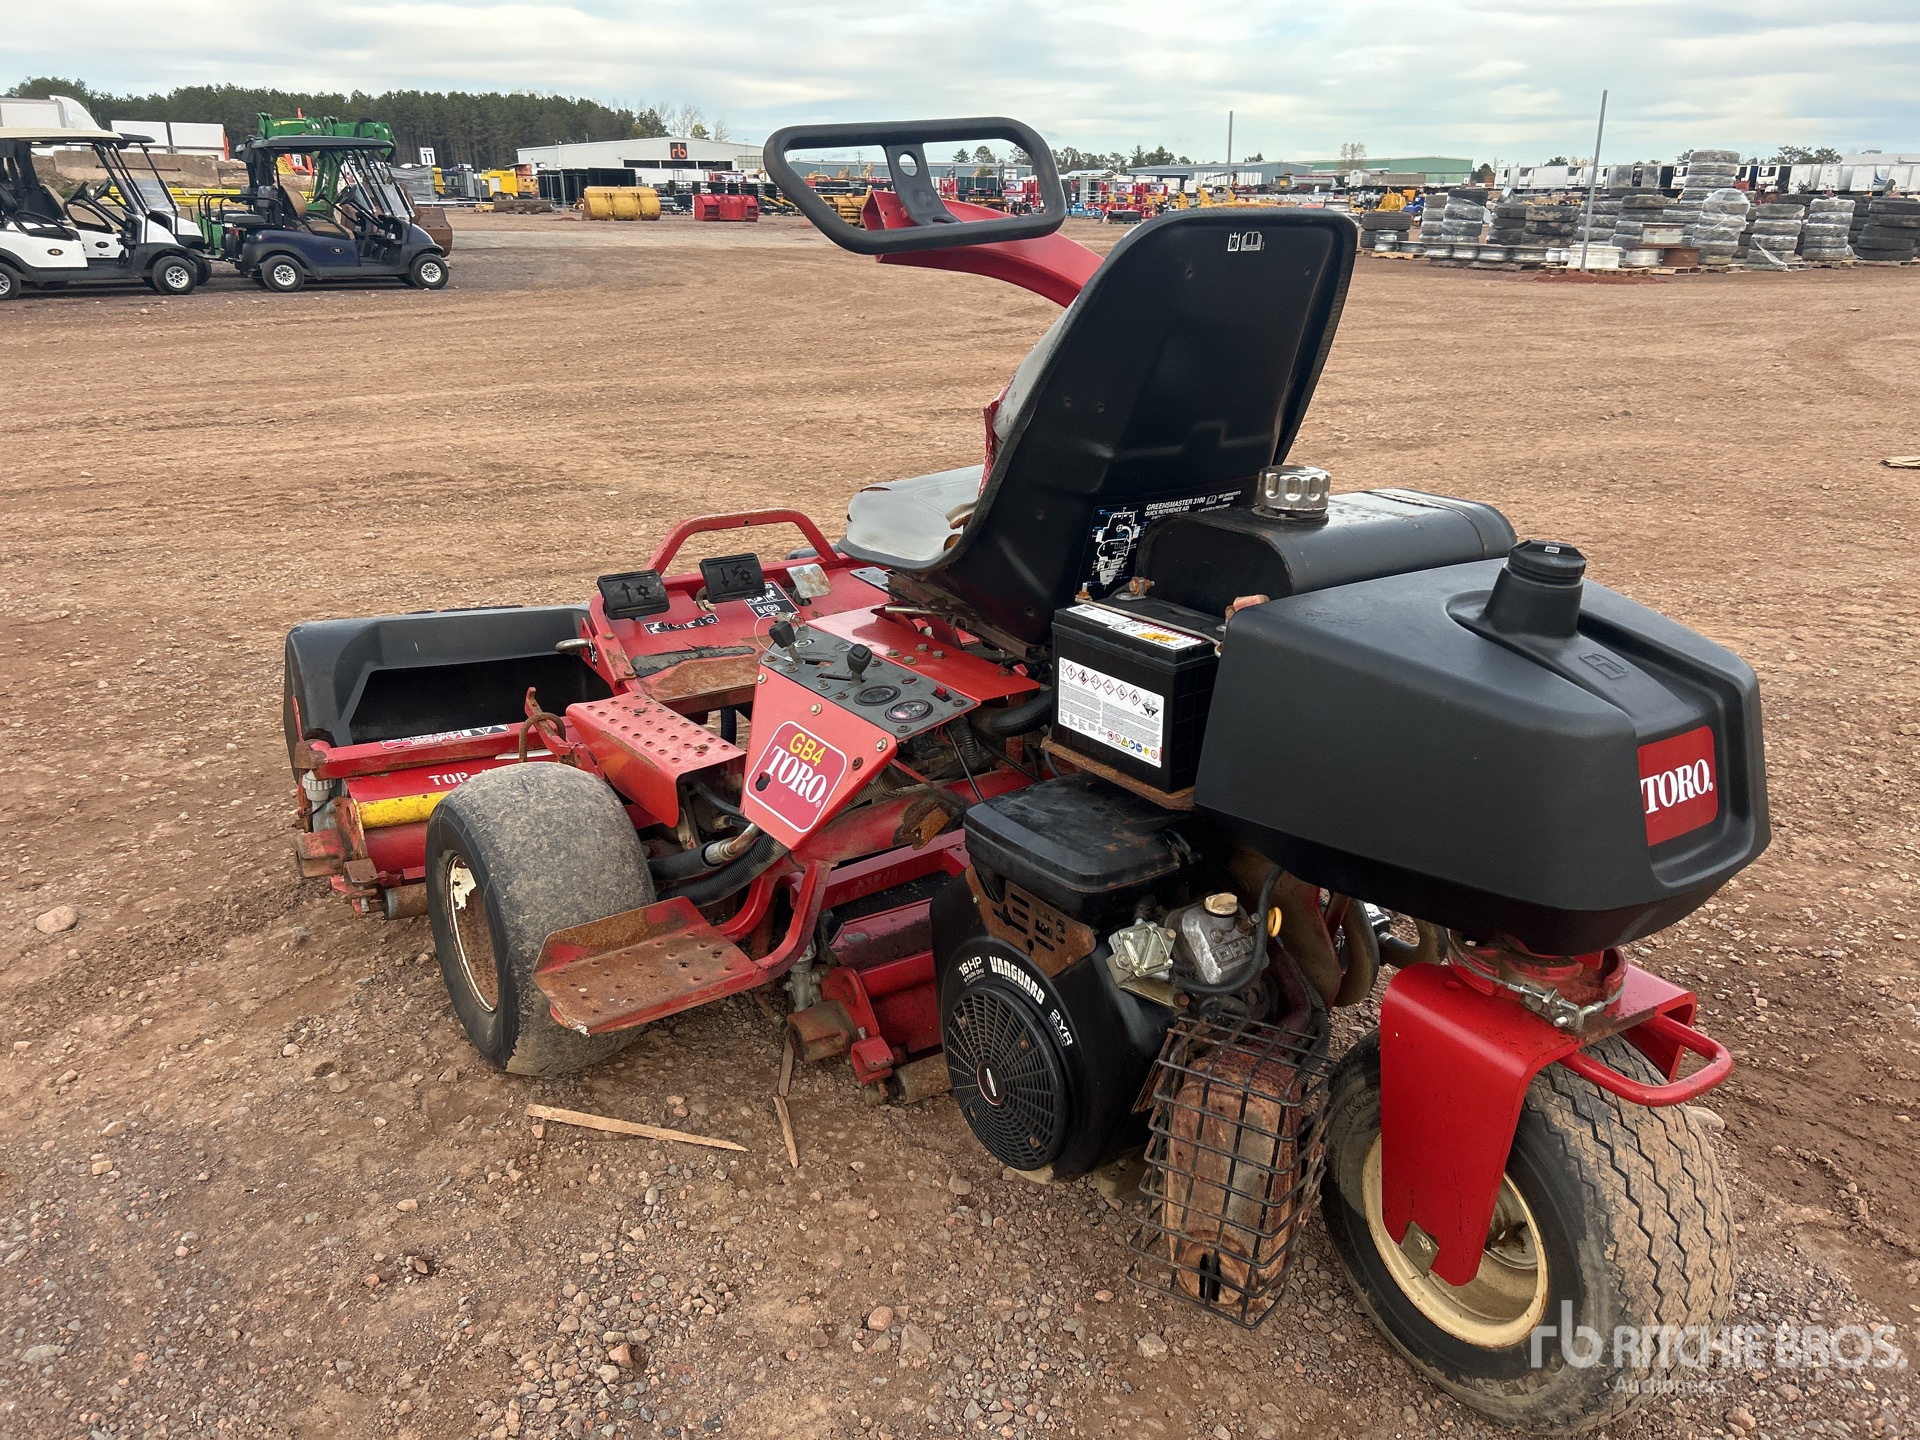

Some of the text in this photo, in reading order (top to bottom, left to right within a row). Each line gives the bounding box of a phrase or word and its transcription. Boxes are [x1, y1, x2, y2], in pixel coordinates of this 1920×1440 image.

[423, 153, 433, 163] 11
[672, 143, 687, 159] rb
[1146, 498, 1193, 511] GREENSMASTER
[1144, 509, 1158, 517] QUICK
[789, 732, 827, 766] GB4
[428, 772, 468, 786] TOP
[764, 745, 827, 804] TORO
[989, 955, 1046, 1005] VANGUARD
